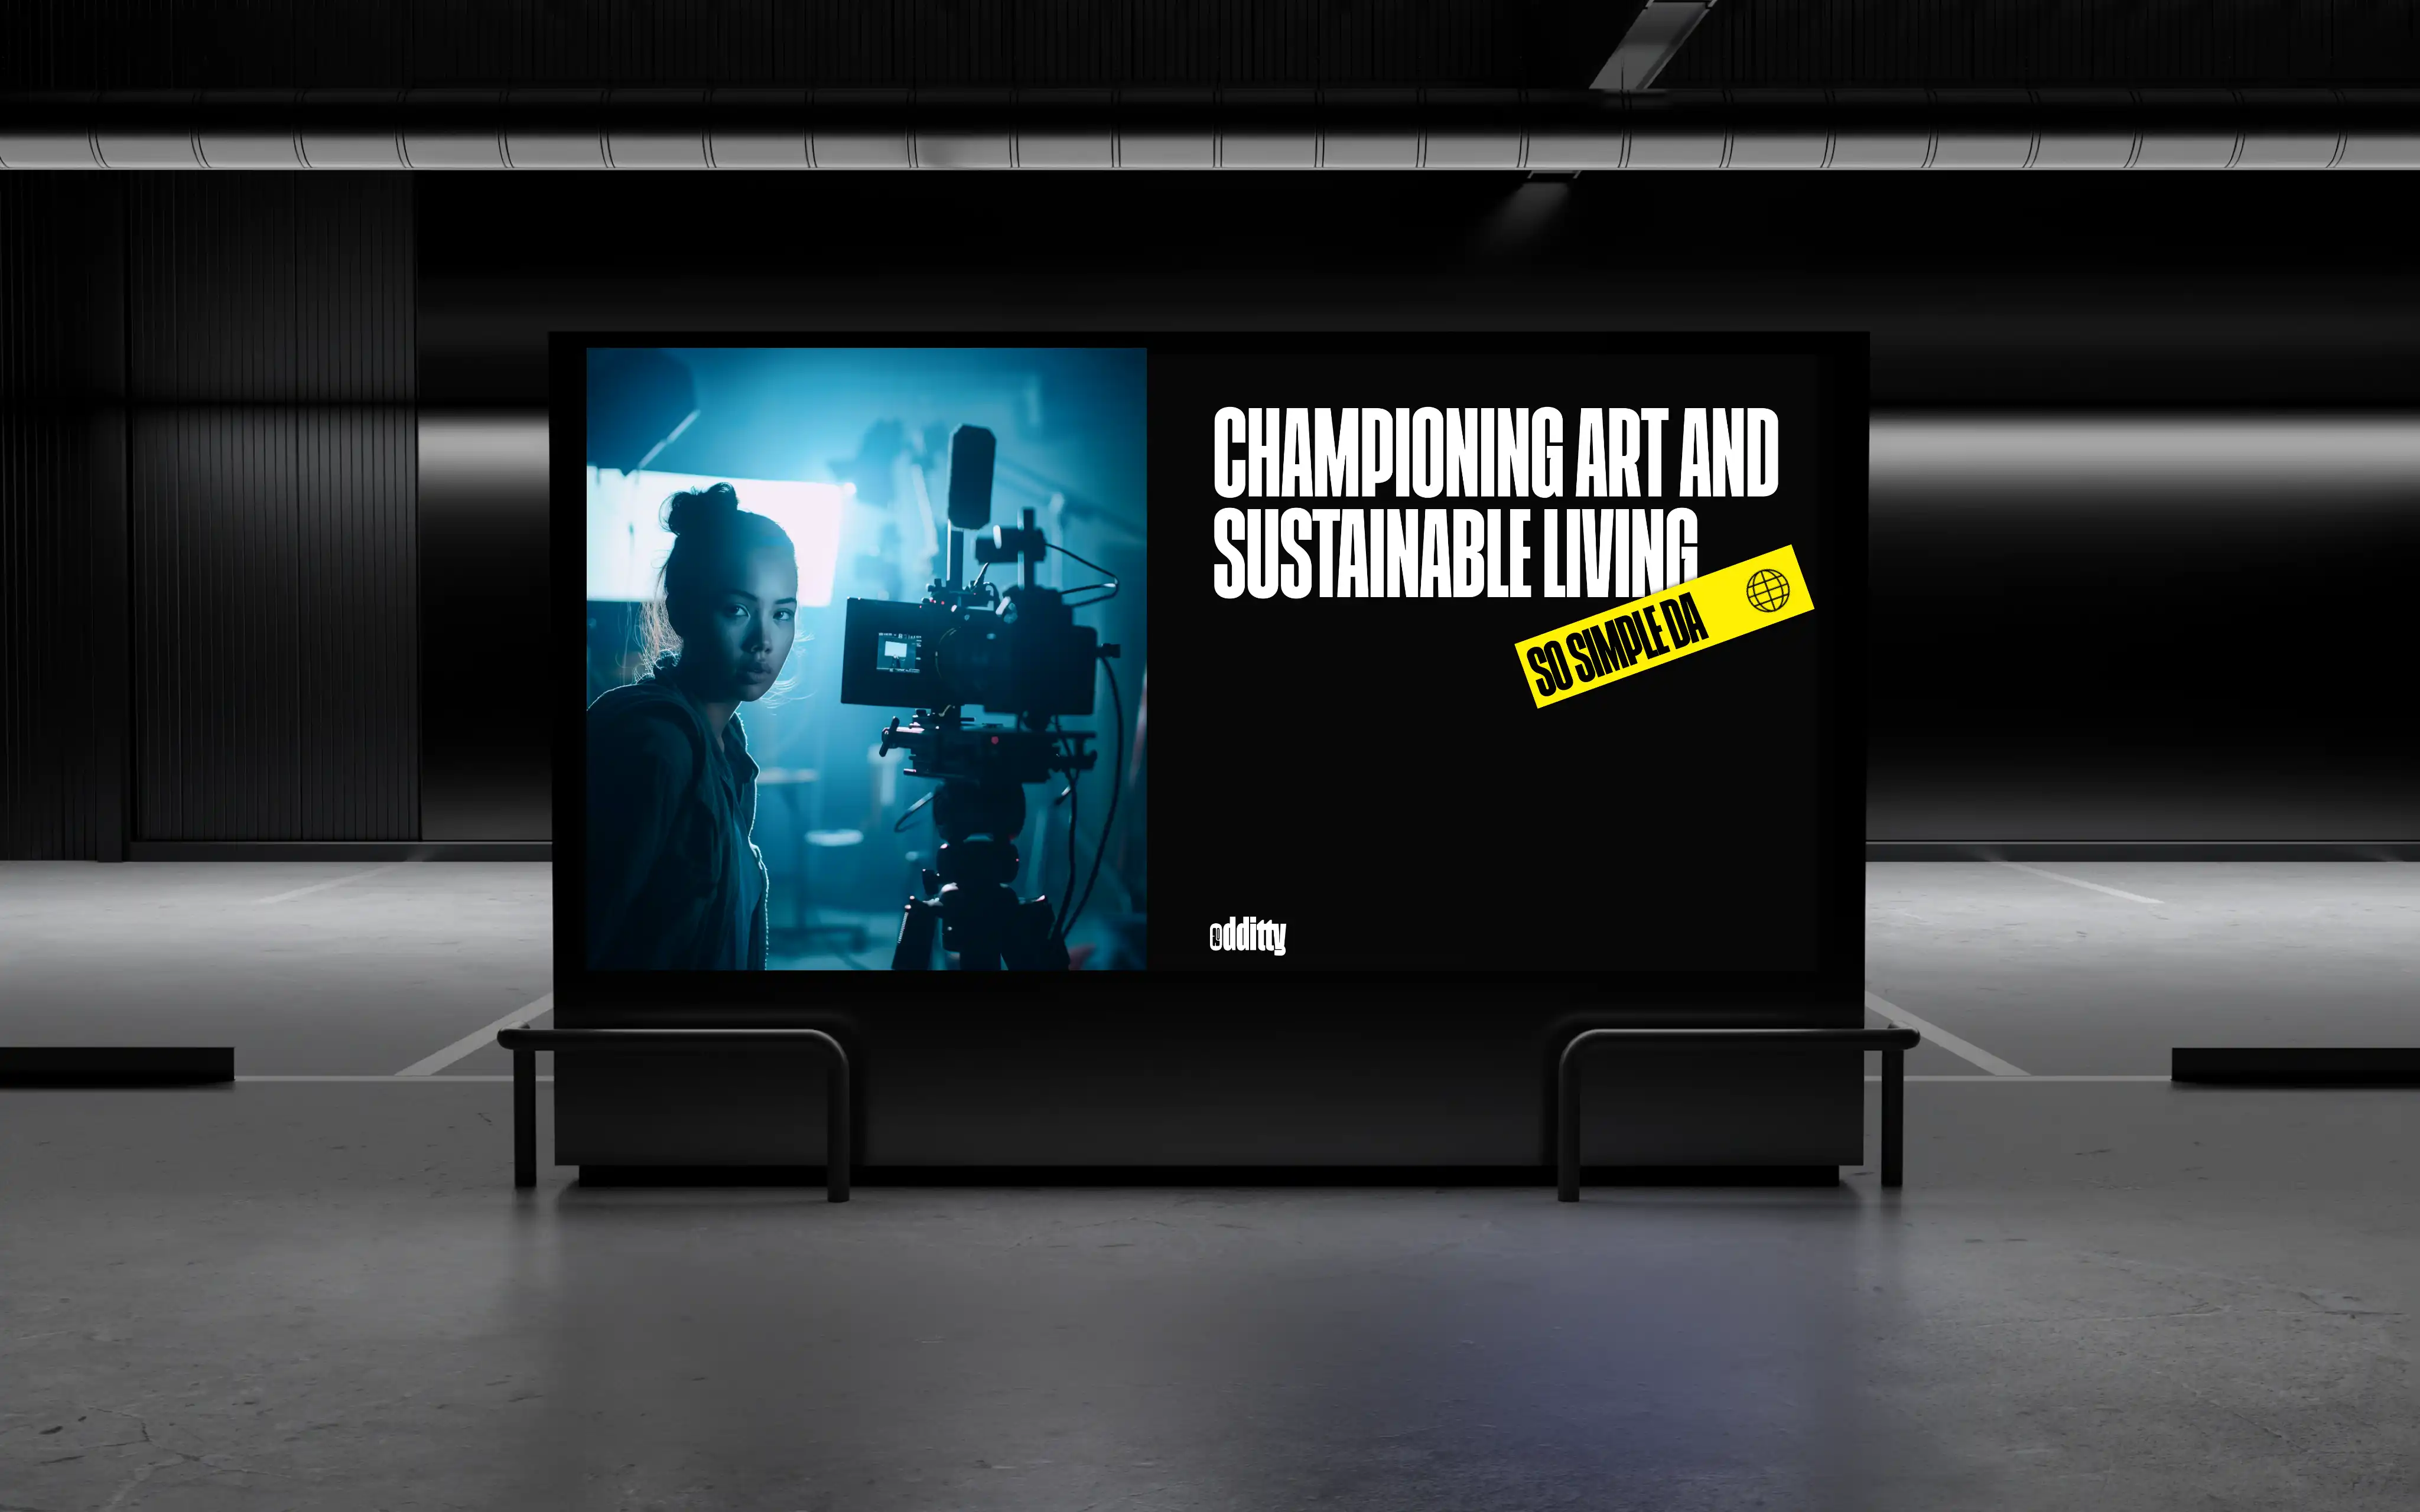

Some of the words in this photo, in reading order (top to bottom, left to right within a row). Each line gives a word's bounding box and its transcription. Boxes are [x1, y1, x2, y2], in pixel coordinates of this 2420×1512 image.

[1214, 406, 1563, 498] CHAMPIONING
[1575, 408, 1669, 497] ART
[1679, 408, 1779, 497] AND
[1214, 507, 1532, 599] SUSTAINABLE
[1543, 507, 1698, 598] LIVING
[1526, 640, 1574, 697] SO
[1566, 605, 1671, 683] SIMPLE
[1659, 591, 1709, 650] DA
